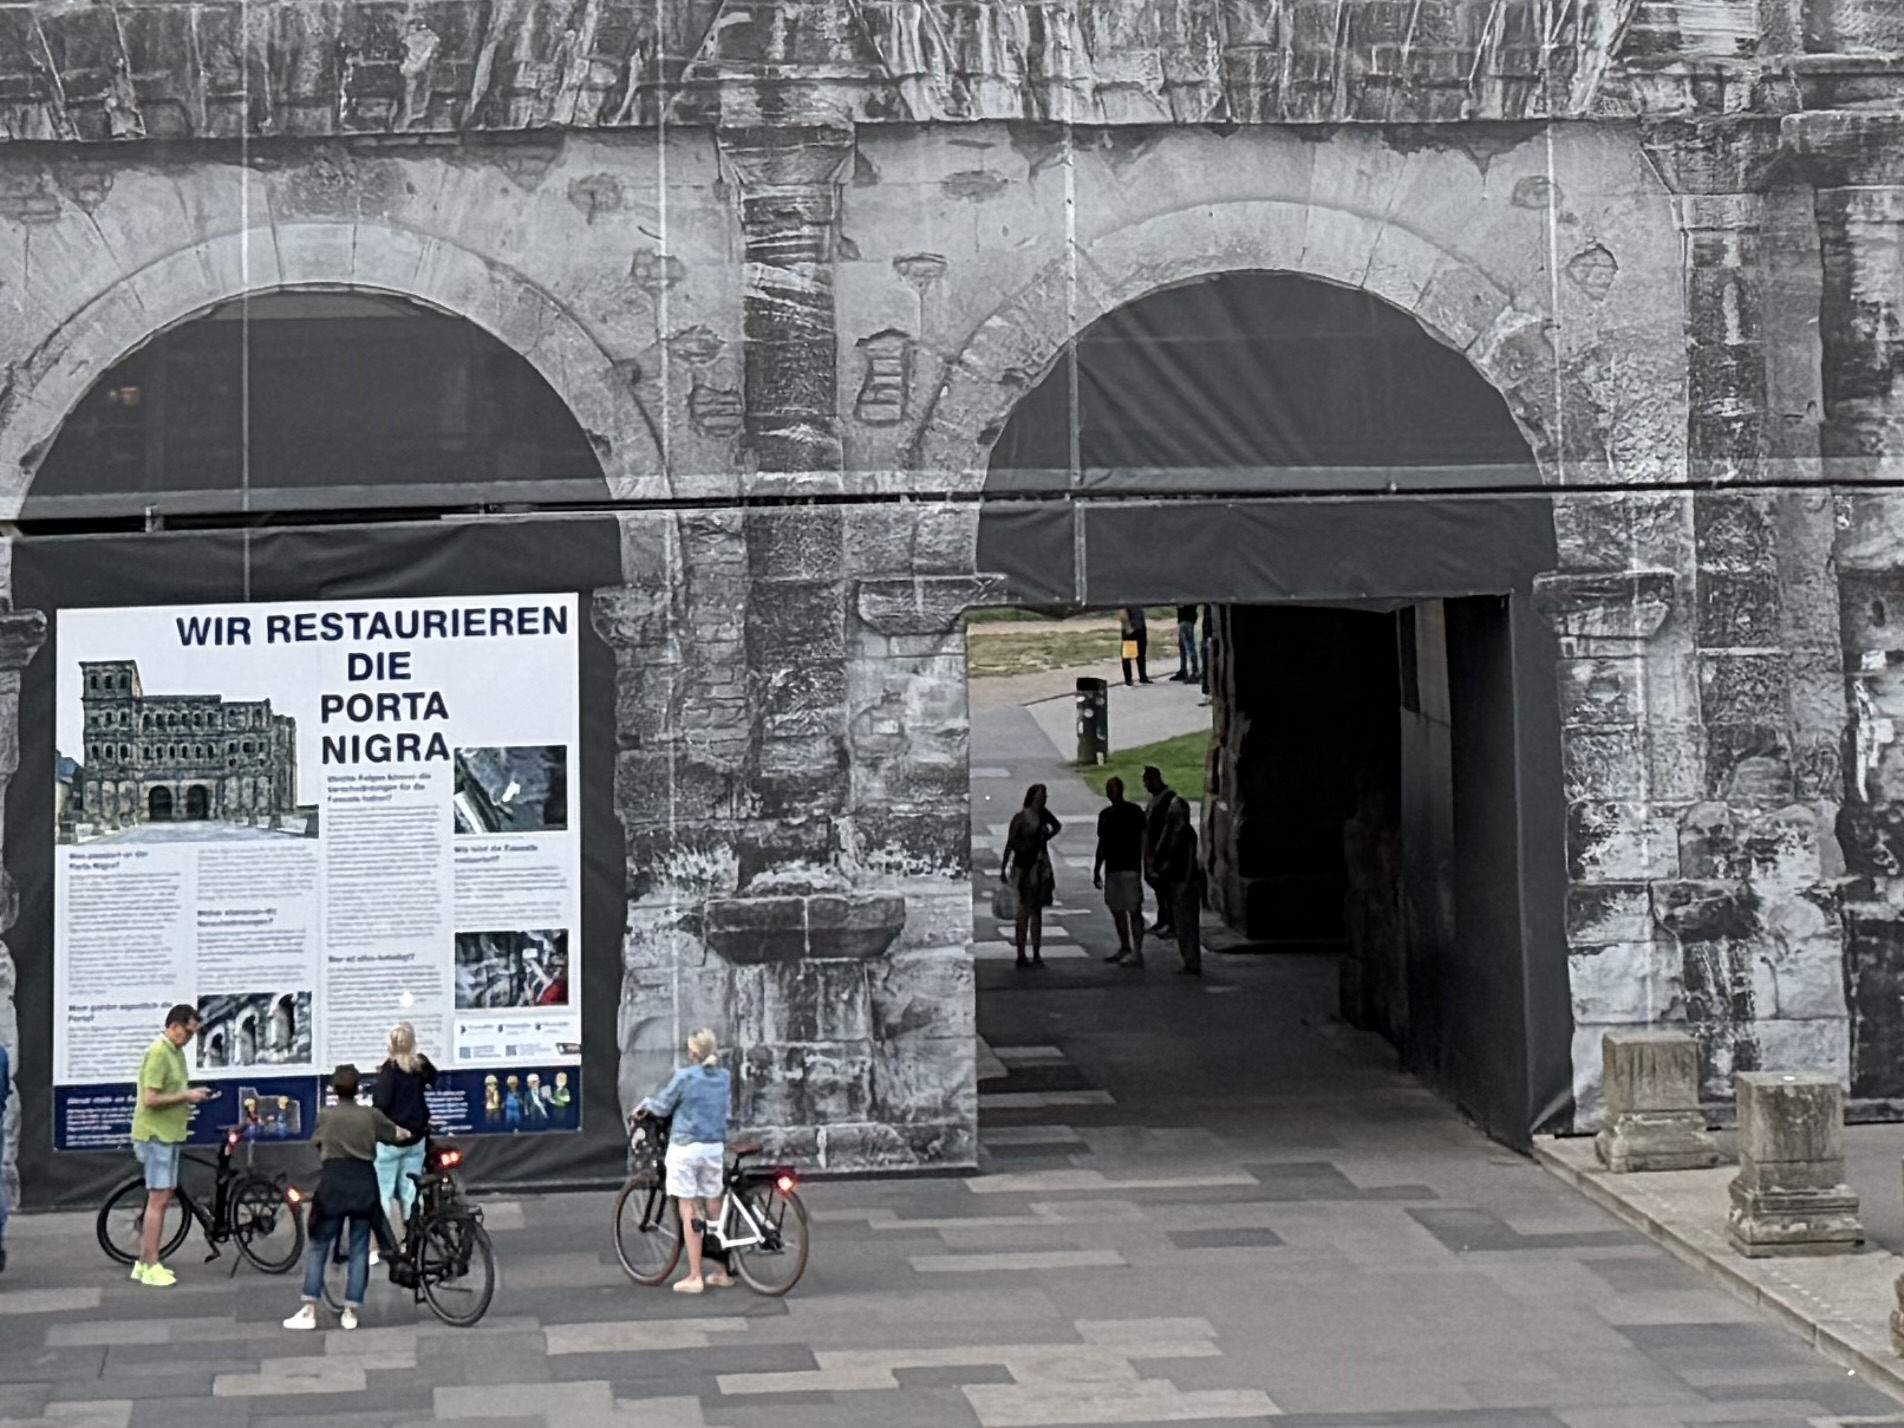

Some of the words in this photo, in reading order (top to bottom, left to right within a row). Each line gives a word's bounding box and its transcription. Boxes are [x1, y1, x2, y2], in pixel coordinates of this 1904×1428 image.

[176, 616, 252, 646] WIR
[266, 605, 568, 644] RESTAURIEREN
[347, 651, 412, 681] DIE
[321, 691, 450, 724] PORTA
[322, 732, 451, 765] NIGRA
